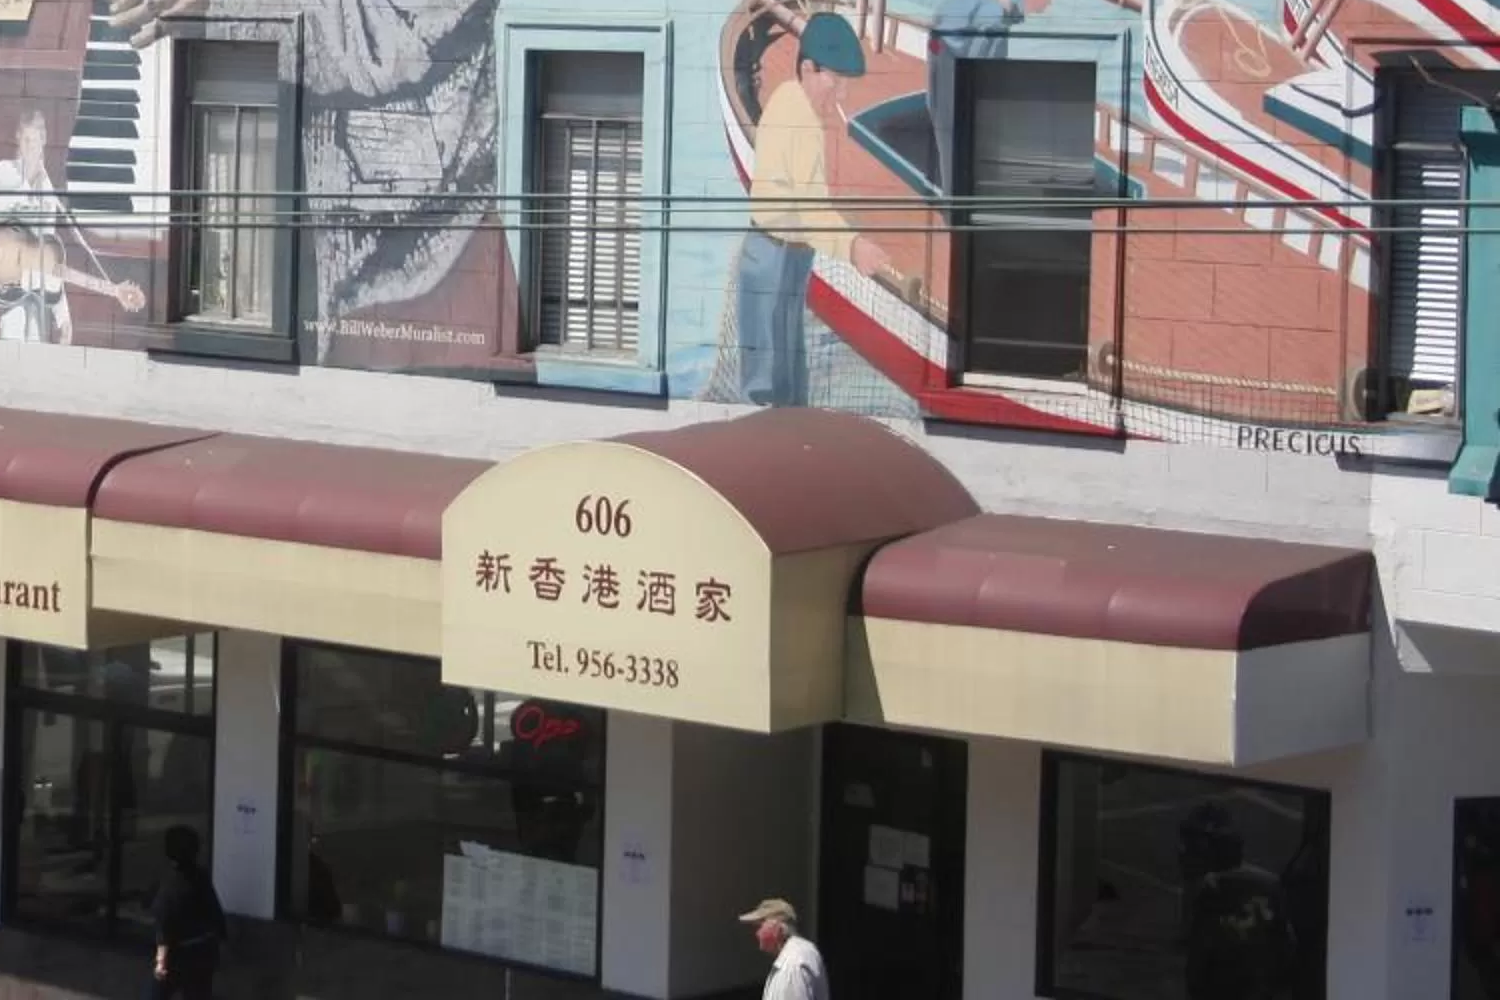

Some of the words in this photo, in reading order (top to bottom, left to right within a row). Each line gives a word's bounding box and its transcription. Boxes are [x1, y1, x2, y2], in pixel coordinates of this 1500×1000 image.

[1237, 425, 1363, 457] PRECIOUS
[574, 495, 633, 538] 606
[475, 549, 733, 624] 新香港酒家
[527, 640, 570, 676] Tel.
[575, 648, 680, 689] 956-3338
